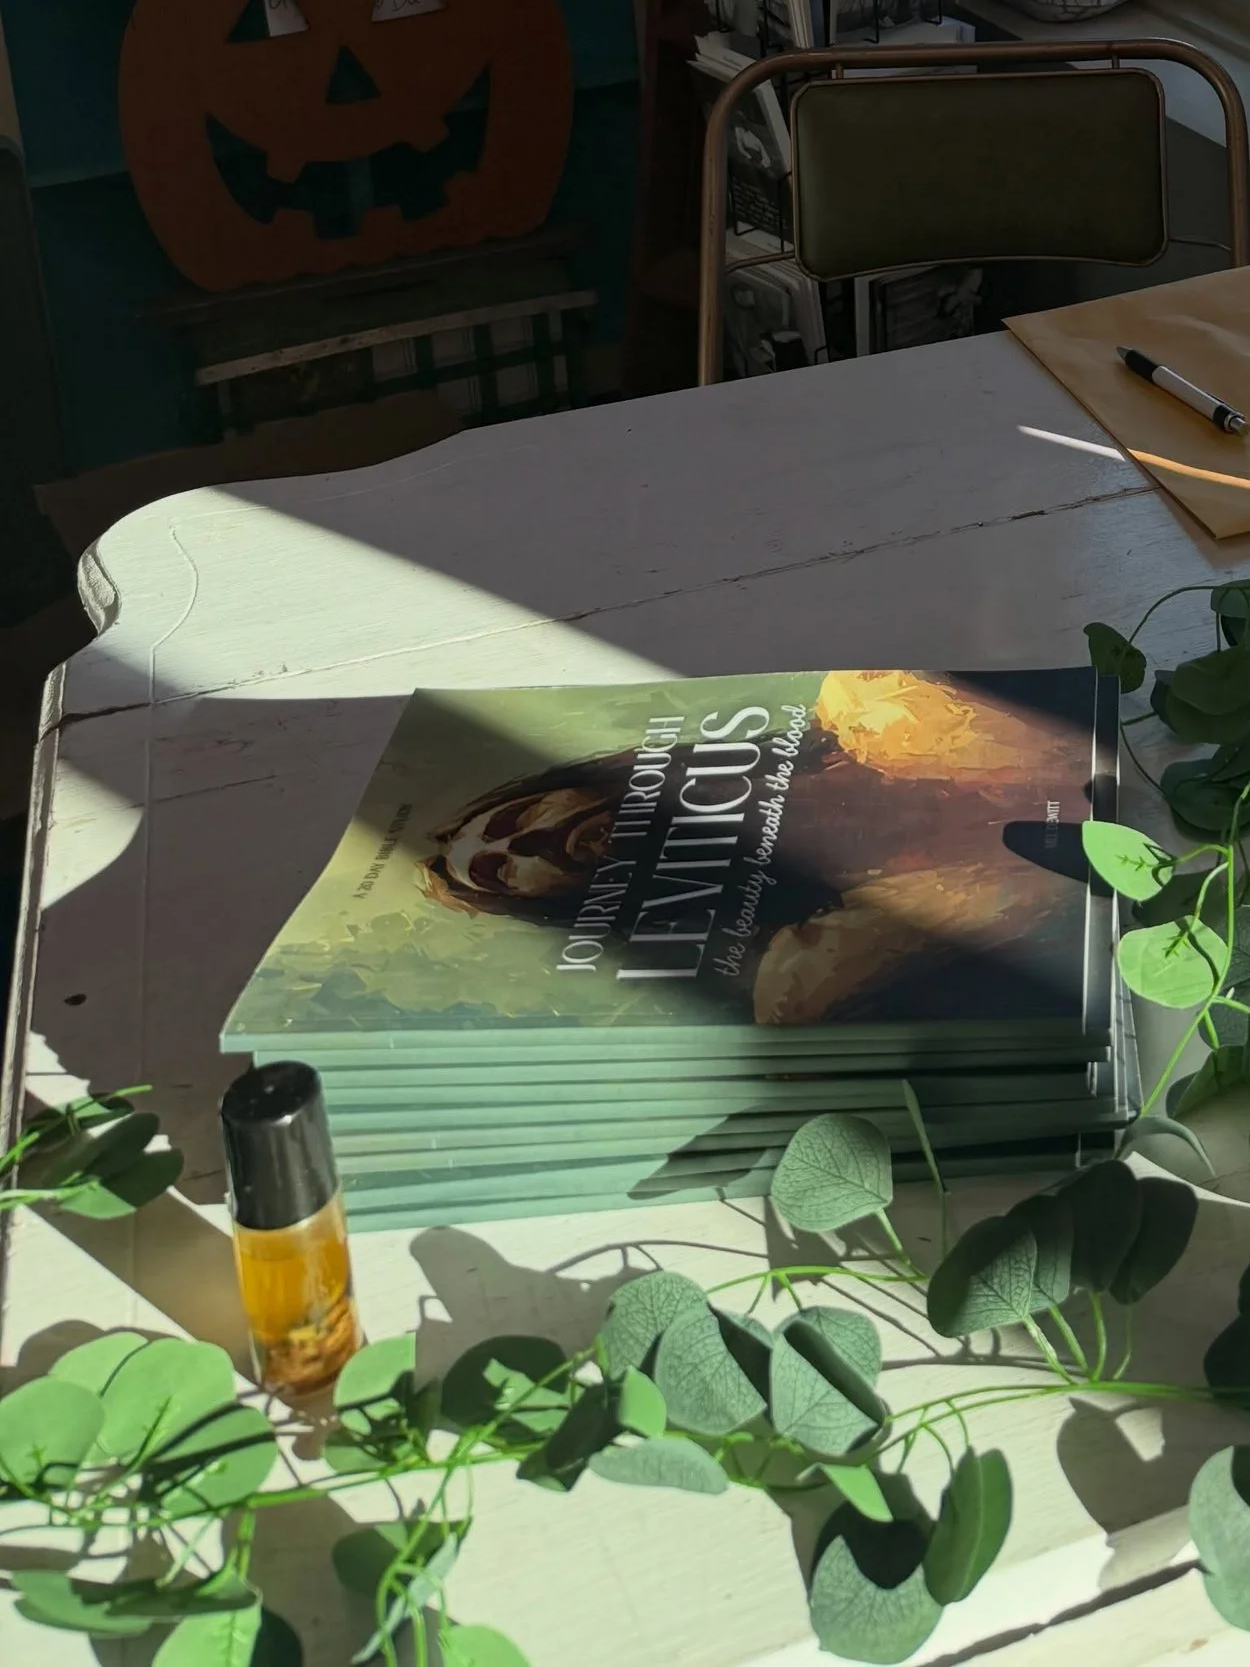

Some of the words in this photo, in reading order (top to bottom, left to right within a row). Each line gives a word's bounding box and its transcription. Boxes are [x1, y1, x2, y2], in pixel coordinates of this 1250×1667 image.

[772, 702, 808, 758] blood
[765, 752, 795, 793] the
[363, 863, 385, 879] DAY
[374, 837, 398, 860] BIBLE
[556, 856, 637, 974] JOURNEY
[610, 715, 685, 840] THROUGH
[616, 705, 770, 982] LEVITICUS
[755, 794, 786, 864] beneath
[735, 856, 778, 944] beauty
[713, 928, 746, 978] the
